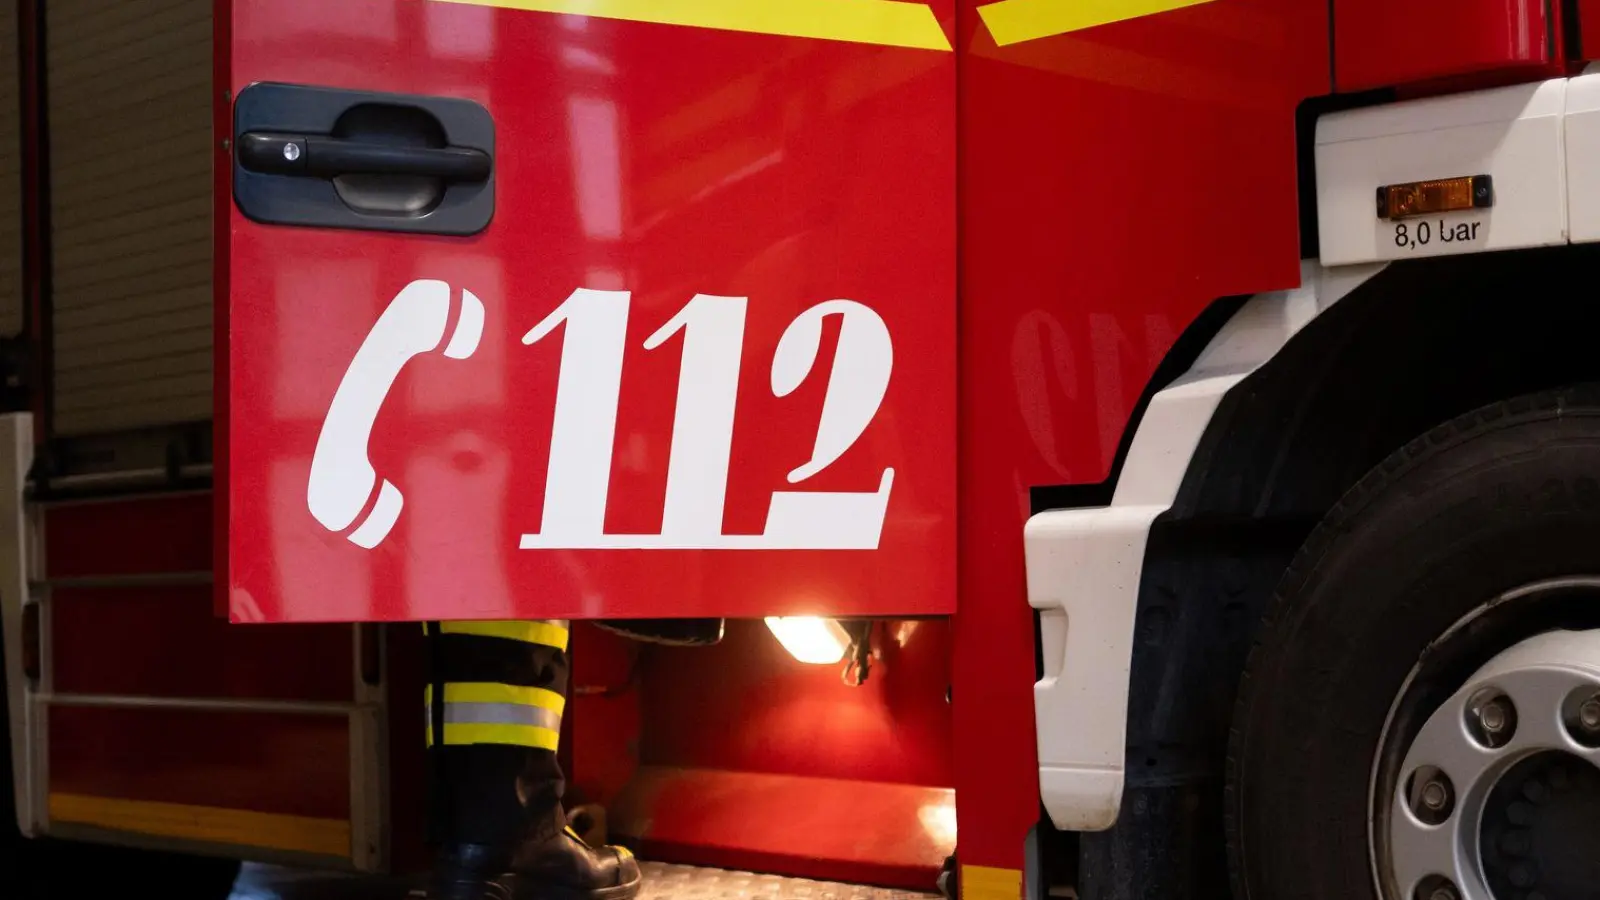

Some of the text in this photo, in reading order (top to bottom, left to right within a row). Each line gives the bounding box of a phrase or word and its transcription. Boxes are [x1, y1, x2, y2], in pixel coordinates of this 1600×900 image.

[1394, 219, 1481, 250] 8,0 bar
[519, 288, 895, 550] 112
